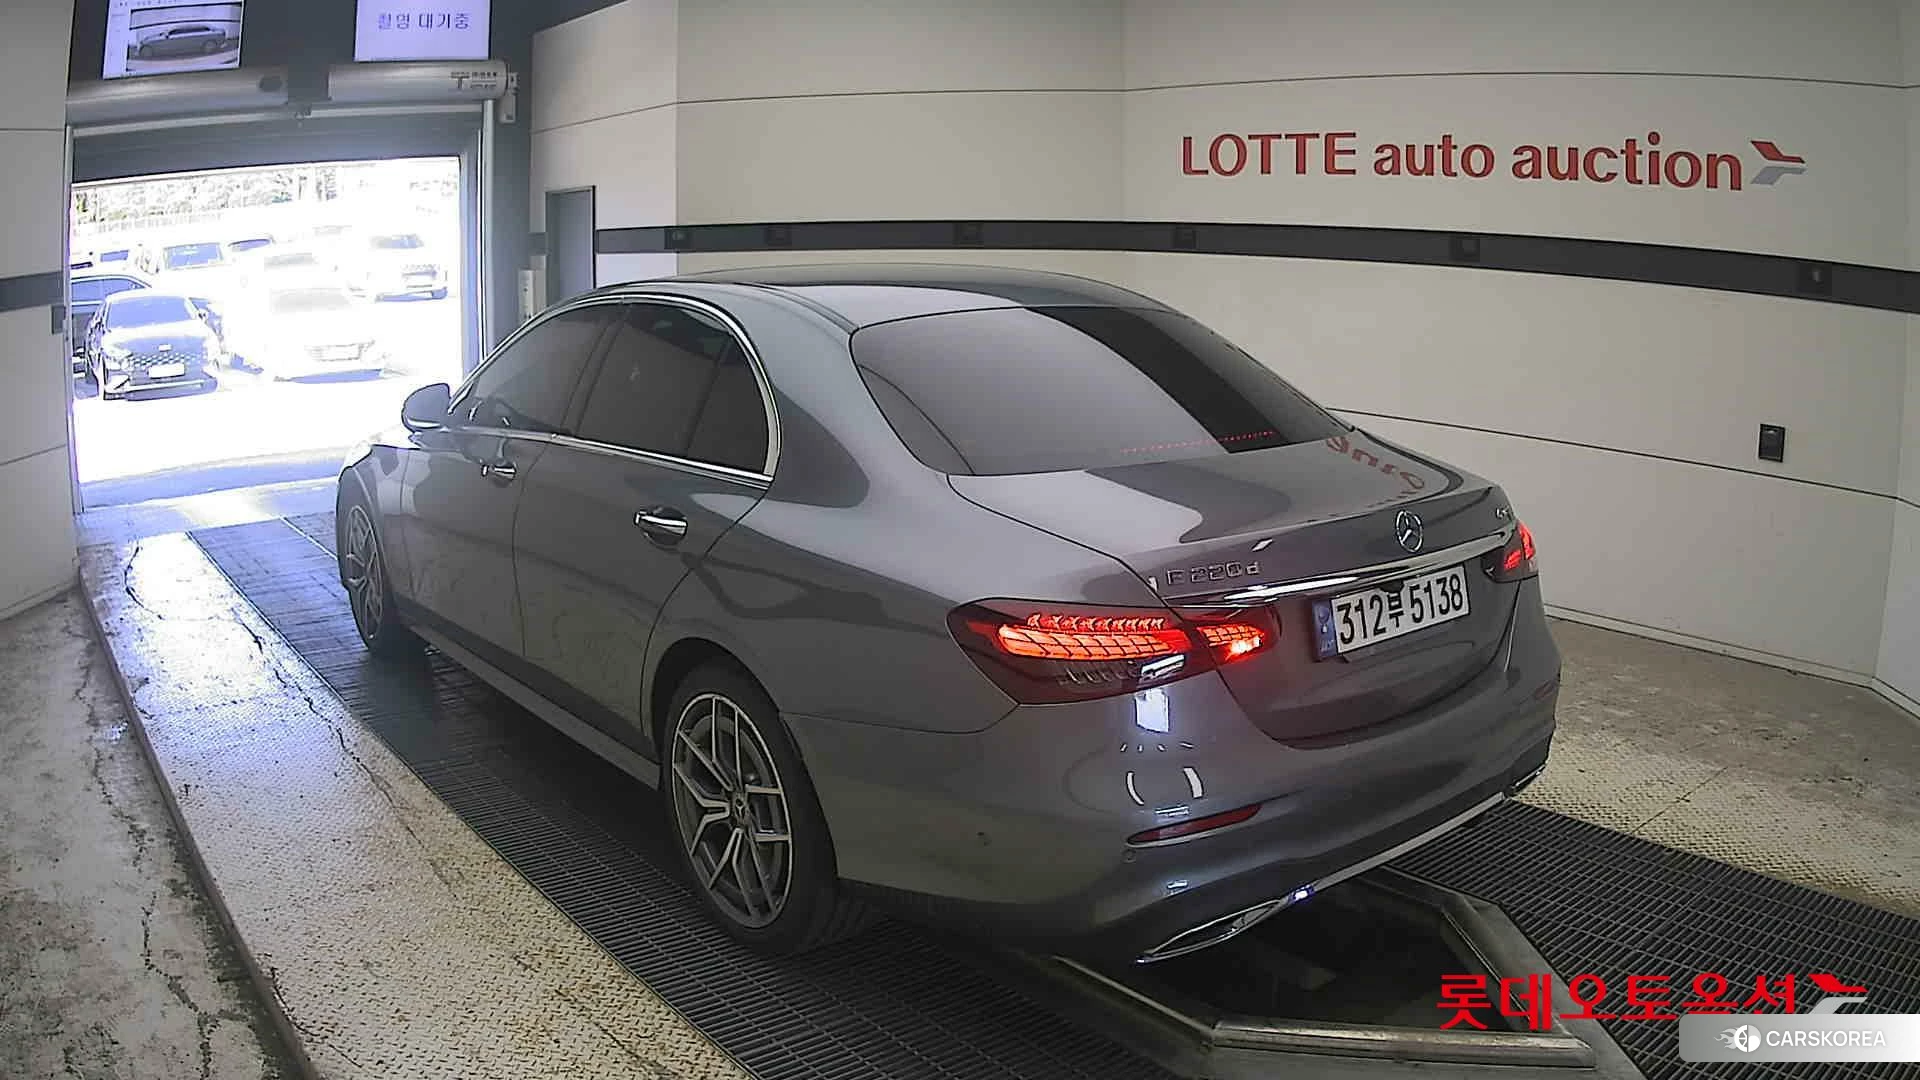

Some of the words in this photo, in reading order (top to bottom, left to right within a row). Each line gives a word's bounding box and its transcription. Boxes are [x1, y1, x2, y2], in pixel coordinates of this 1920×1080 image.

[1182, 131, 1357, 177] LOTTE
[1373, 134, 1495, 178] auto
[1511, 131, 1742, 191] auction
